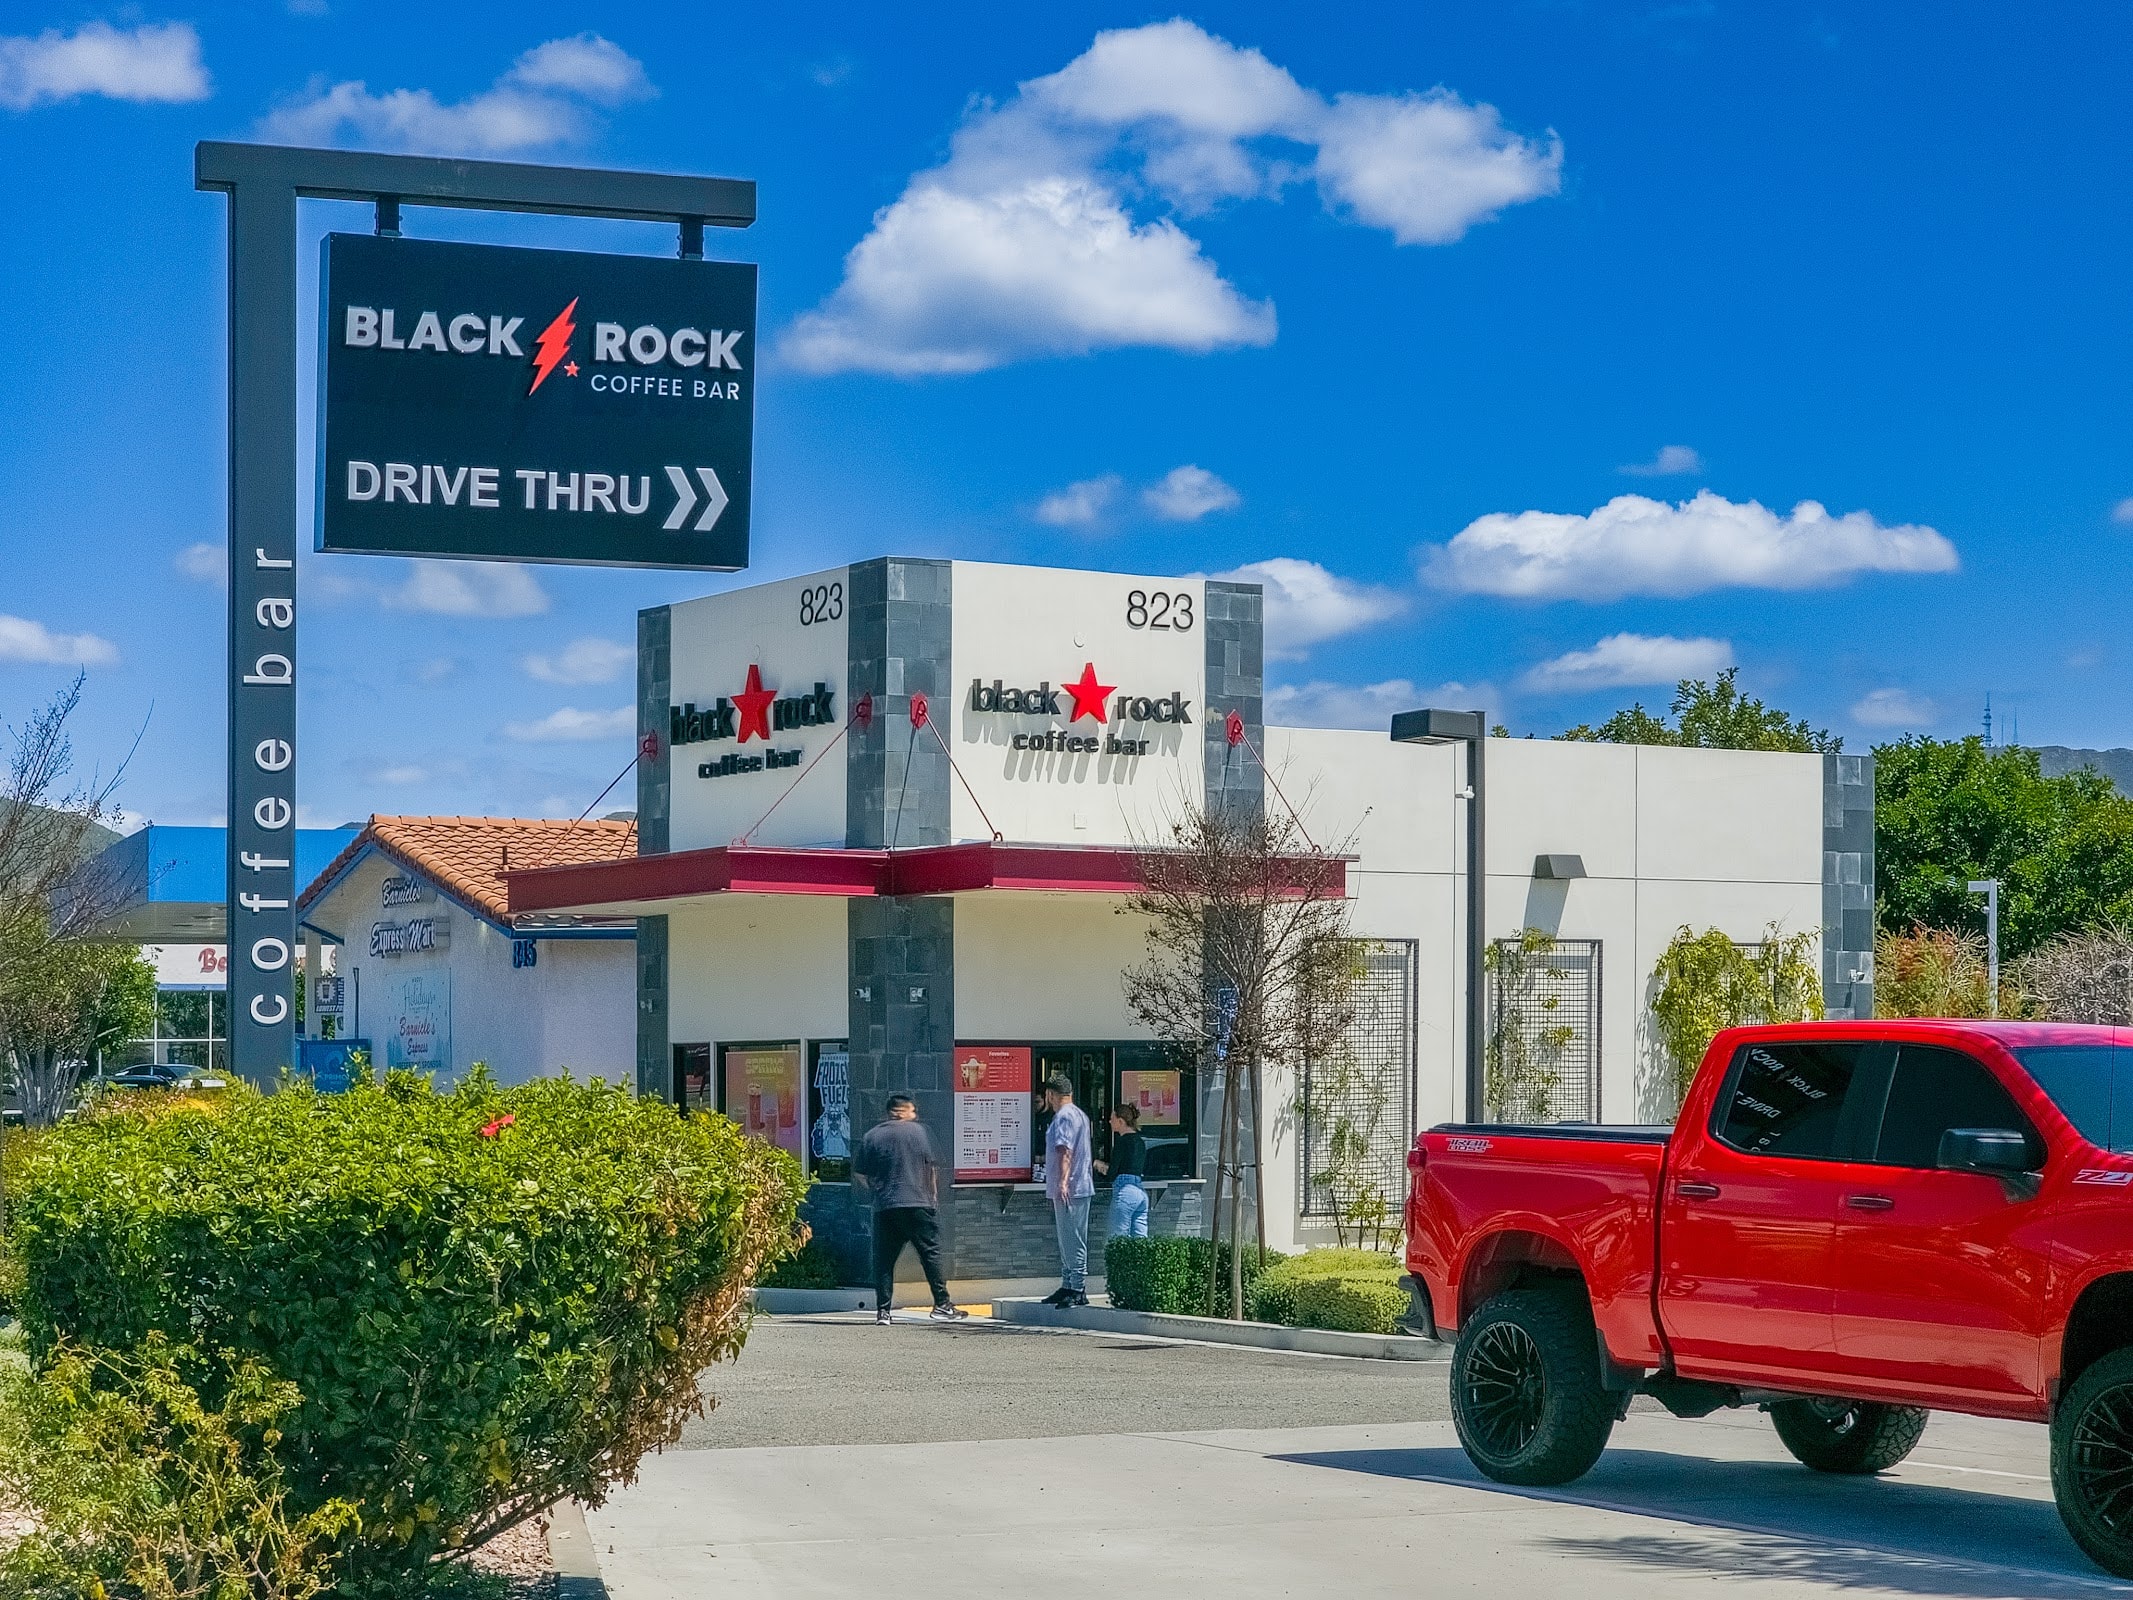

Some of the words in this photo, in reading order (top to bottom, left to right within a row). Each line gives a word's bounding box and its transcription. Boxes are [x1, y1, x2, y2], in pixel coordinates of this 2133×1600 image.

[345, 305, 526, 357] BLACK
[595, 321, 745, 371] ROCK
[590, 373, 684, 397] COFFEE
[692, 379, 741, 401] BAR
[347, 460, 500, 508] DRIVE
[515, 469, 651, 515] THRU
[243, 548, 294, 685] bar
[800, 582, 844, 627] 823
[1126, 590, 1195, 631] 823
[670, 697, 736, 746] black
[773, 682, 836, 732] rock
[972, 678, 1062, 716] black
[1117, 691, 1193, 725] rock
[765, 748, 803, 770] bar
[1013, 730, 1100, 754] coffee
[1106, 733, 1150, 756] bar
[239, 737, 293, 1025] coffee
[370, 922, 404, 959] Express
[408, 919, 436, 951] Mart
[821, 1086, 846, 1105] FUEL
